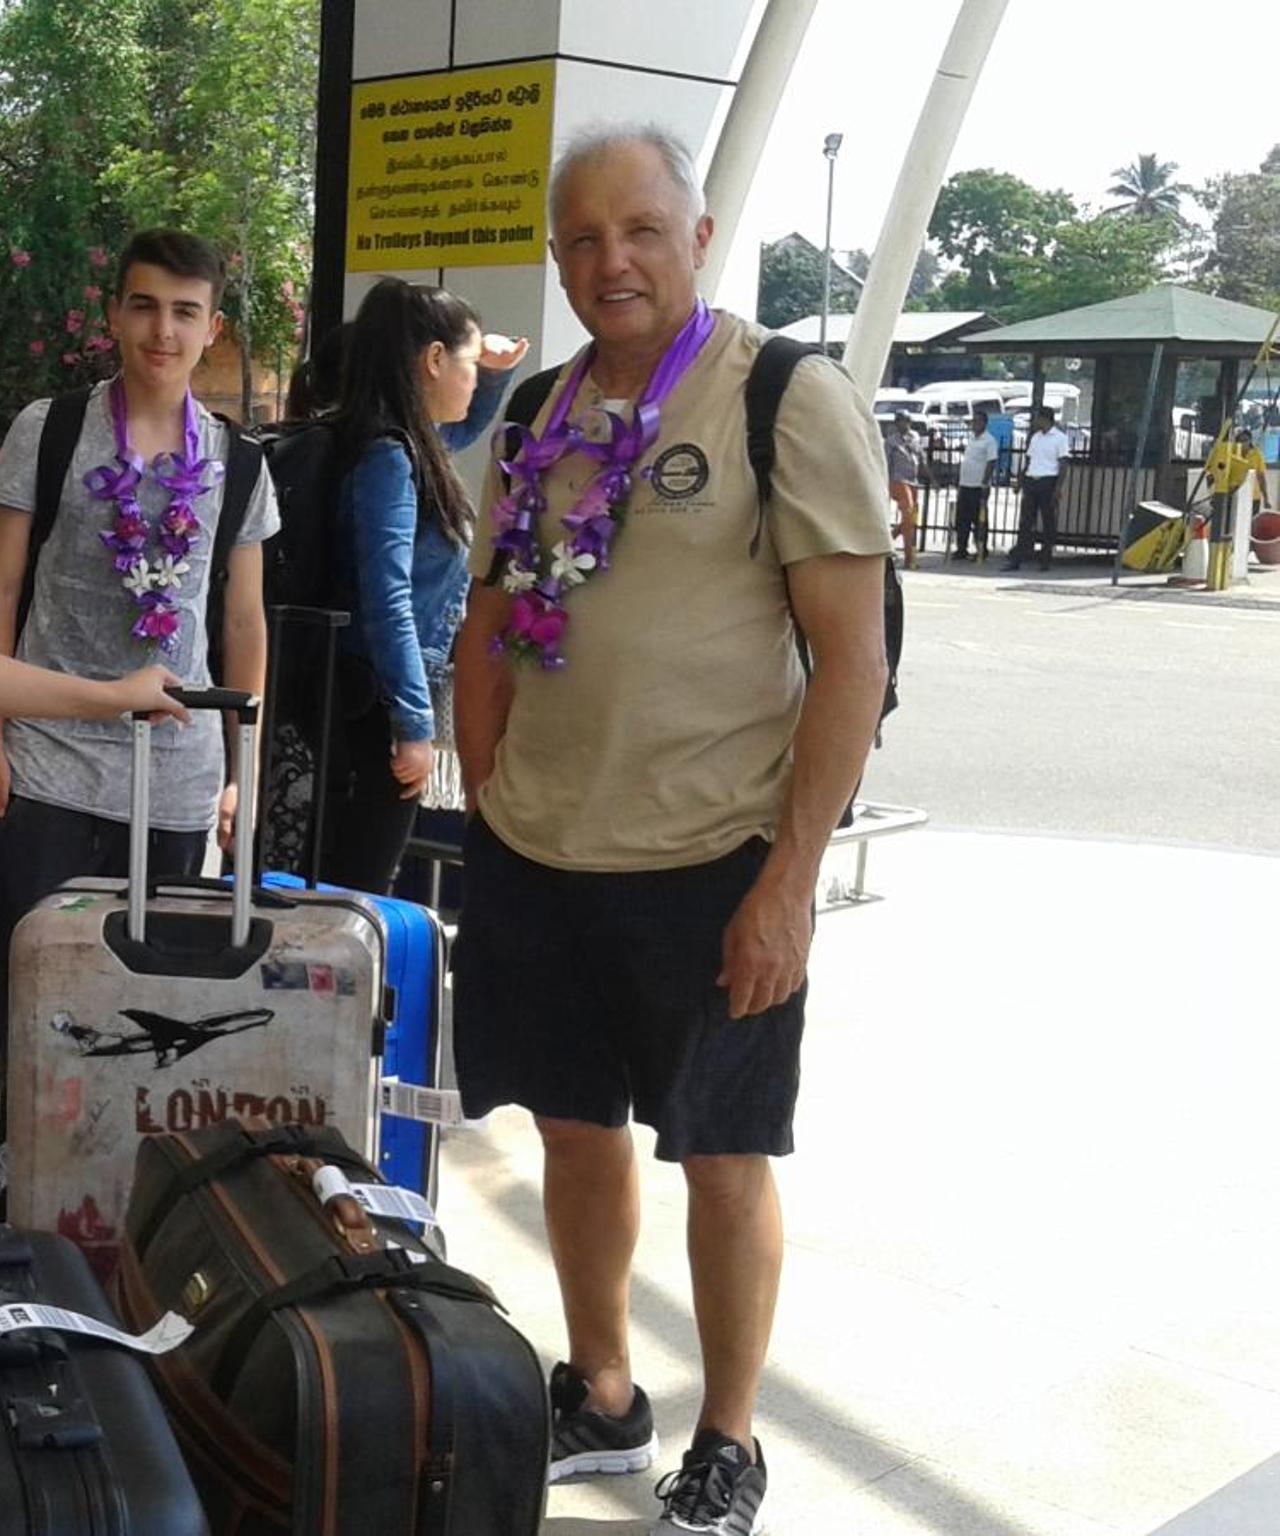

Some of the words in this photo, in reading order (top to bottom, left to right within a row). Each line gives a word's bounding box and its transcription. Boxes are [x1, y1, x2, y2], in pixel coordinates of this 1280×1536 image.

[356, 234, 371, 250] No
[374, 231, 422, 250] Trolleys
[424, 229, 470, 248] Beyond
[472, 225, 497, 244] this
[499, 224, 534, 243] point
